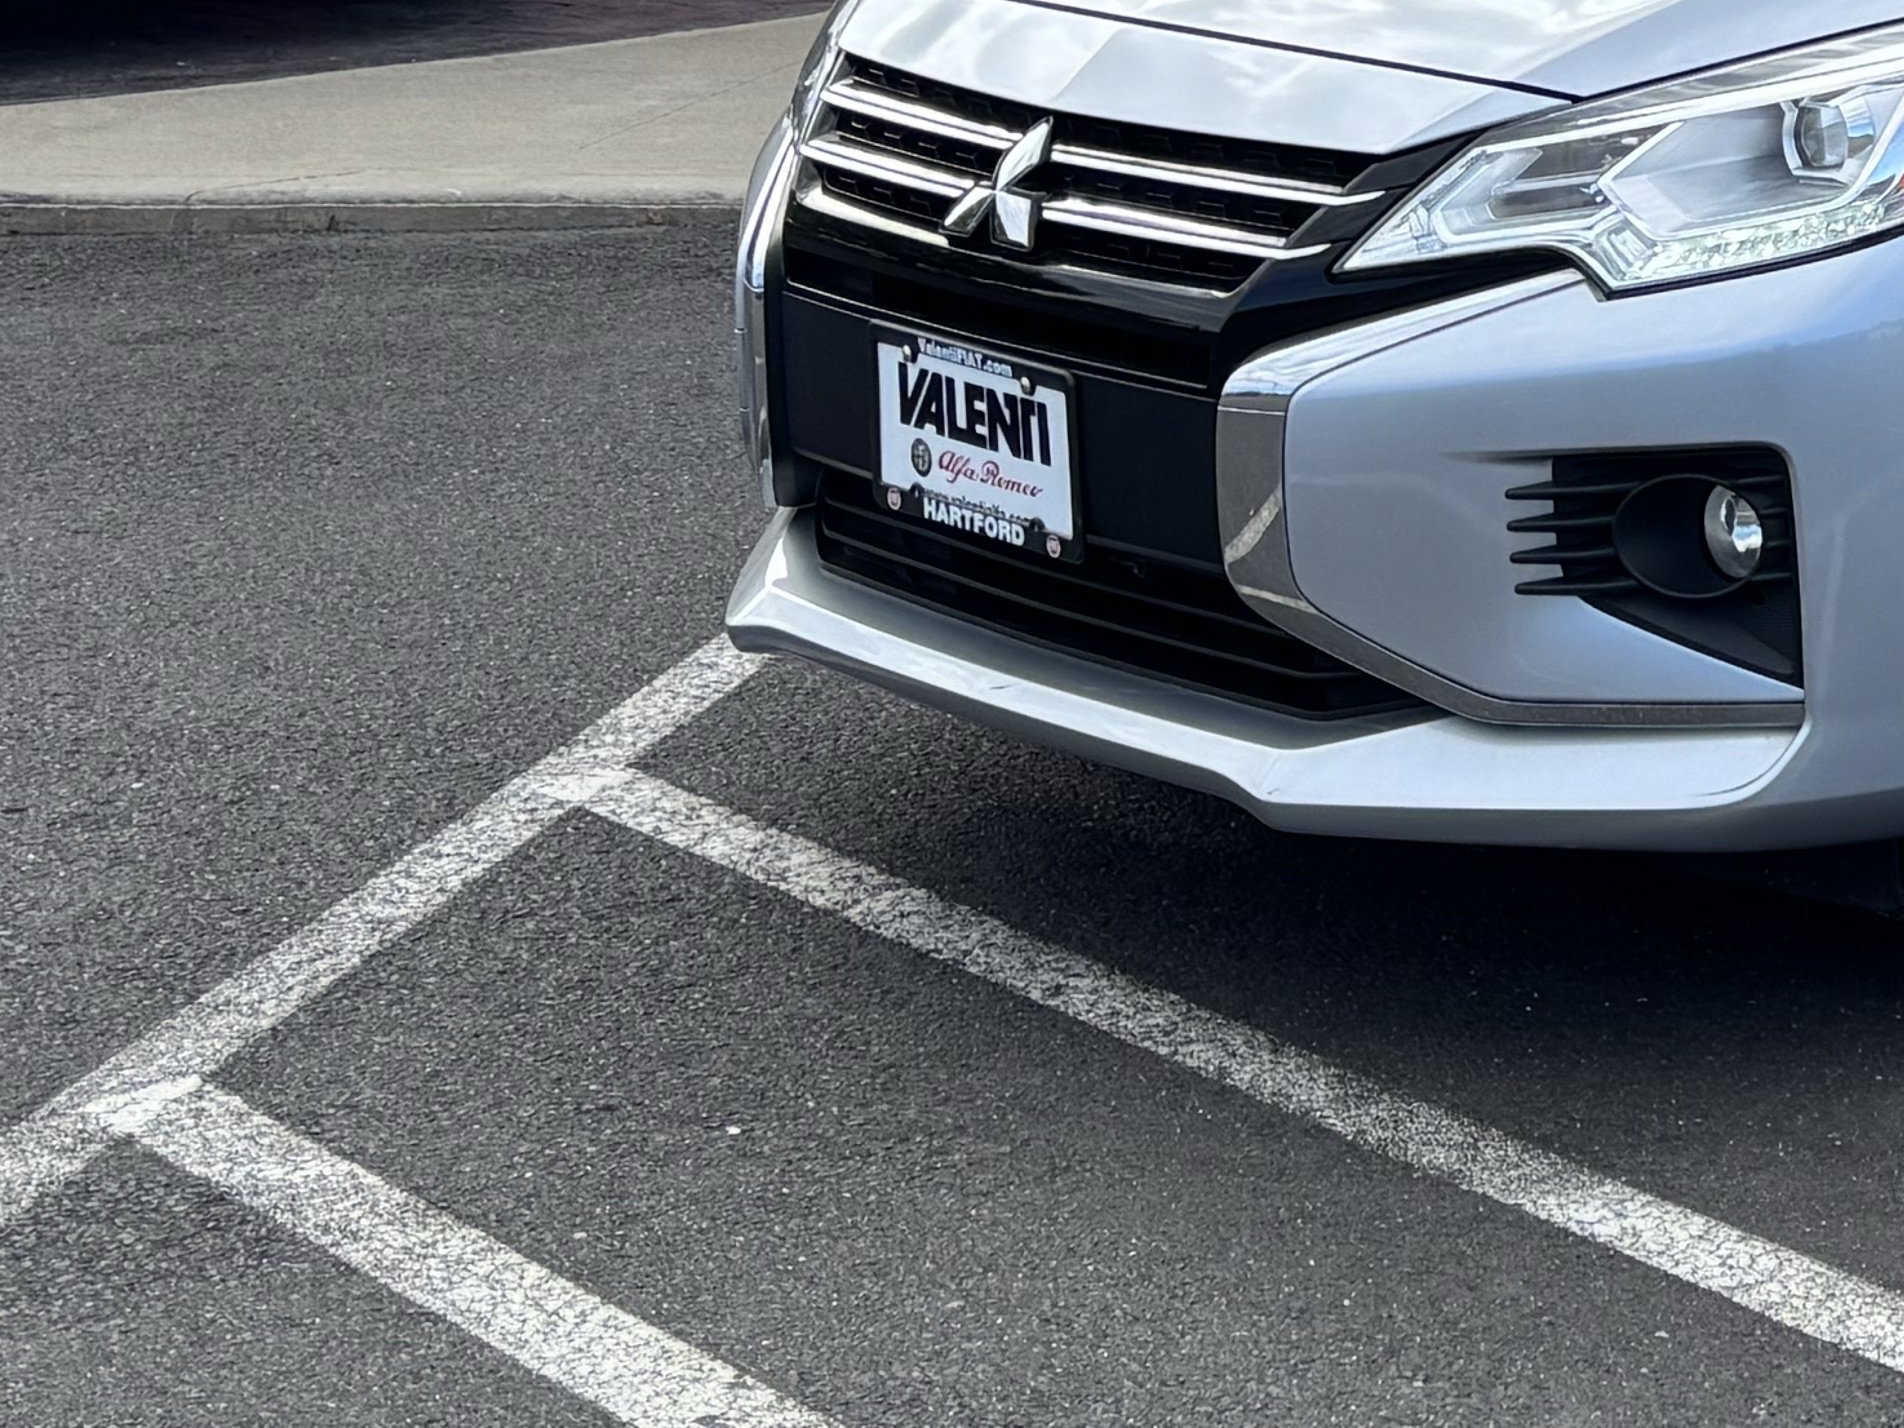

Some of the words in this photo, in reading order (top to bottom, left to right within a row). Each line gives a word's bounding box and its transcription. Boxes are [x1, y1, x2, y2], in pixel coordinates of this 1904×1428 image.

[897, 361, 1052, 467] VALENTI
[938, 450, 980, 484] Alfa
[980, 460, 1043, 498] Romeo
[923, 496, 1025, 546] HARTFORD
